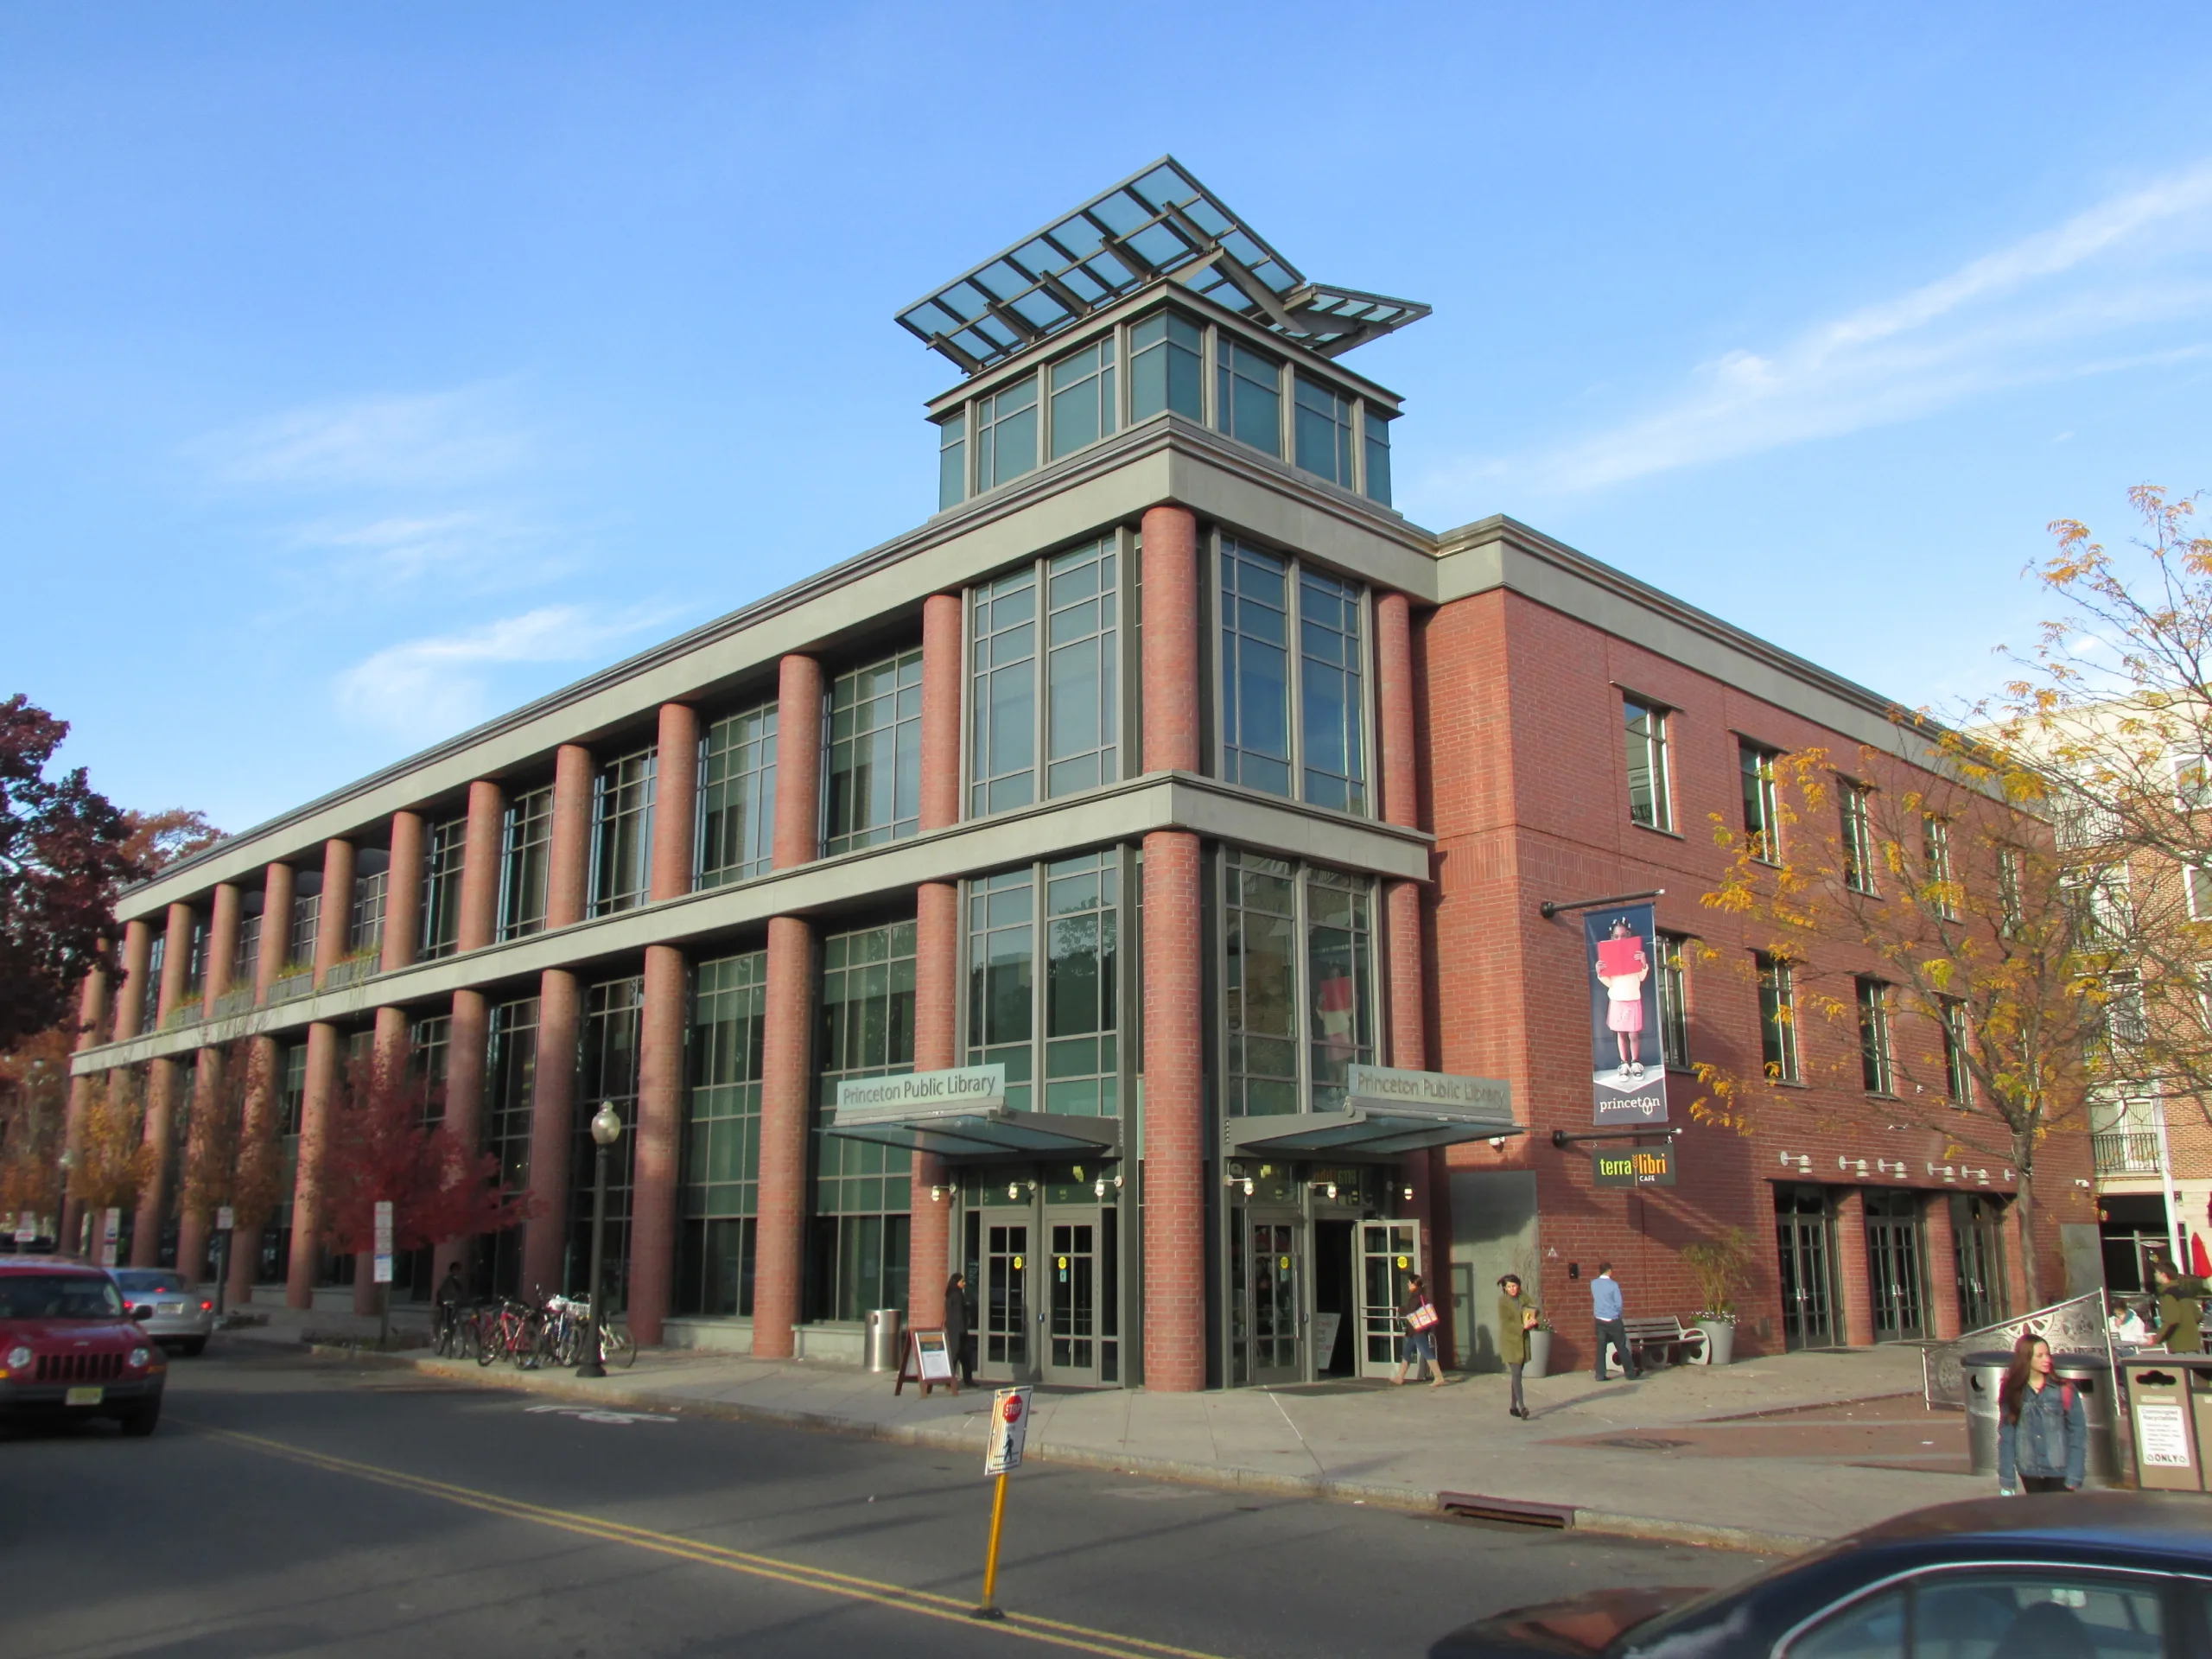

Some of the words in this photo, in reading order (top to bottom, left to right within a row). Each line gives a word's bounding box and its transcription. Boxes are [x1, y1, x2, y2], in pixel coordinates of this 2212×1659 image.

[843, 1085, 900, 1105] Princeton
[904, 1077, 944, 1098] Public
[947, 1075, 996, 1096] Library
[1357, 1071, 1420, 1096] Princeton
[1422, 1078, 1460, 1099] Public
[1465, 1082, 1504, 1108] Library
[1599, 1096, 1661, 1116] princeton
[1599, 1158, 1632, 1176] terra
[1638, 1154, 1667, 1174] libri
[1005, 1402, 1022, 1416] STOP
[2155, 1453, 2178, 1463] ONLY
